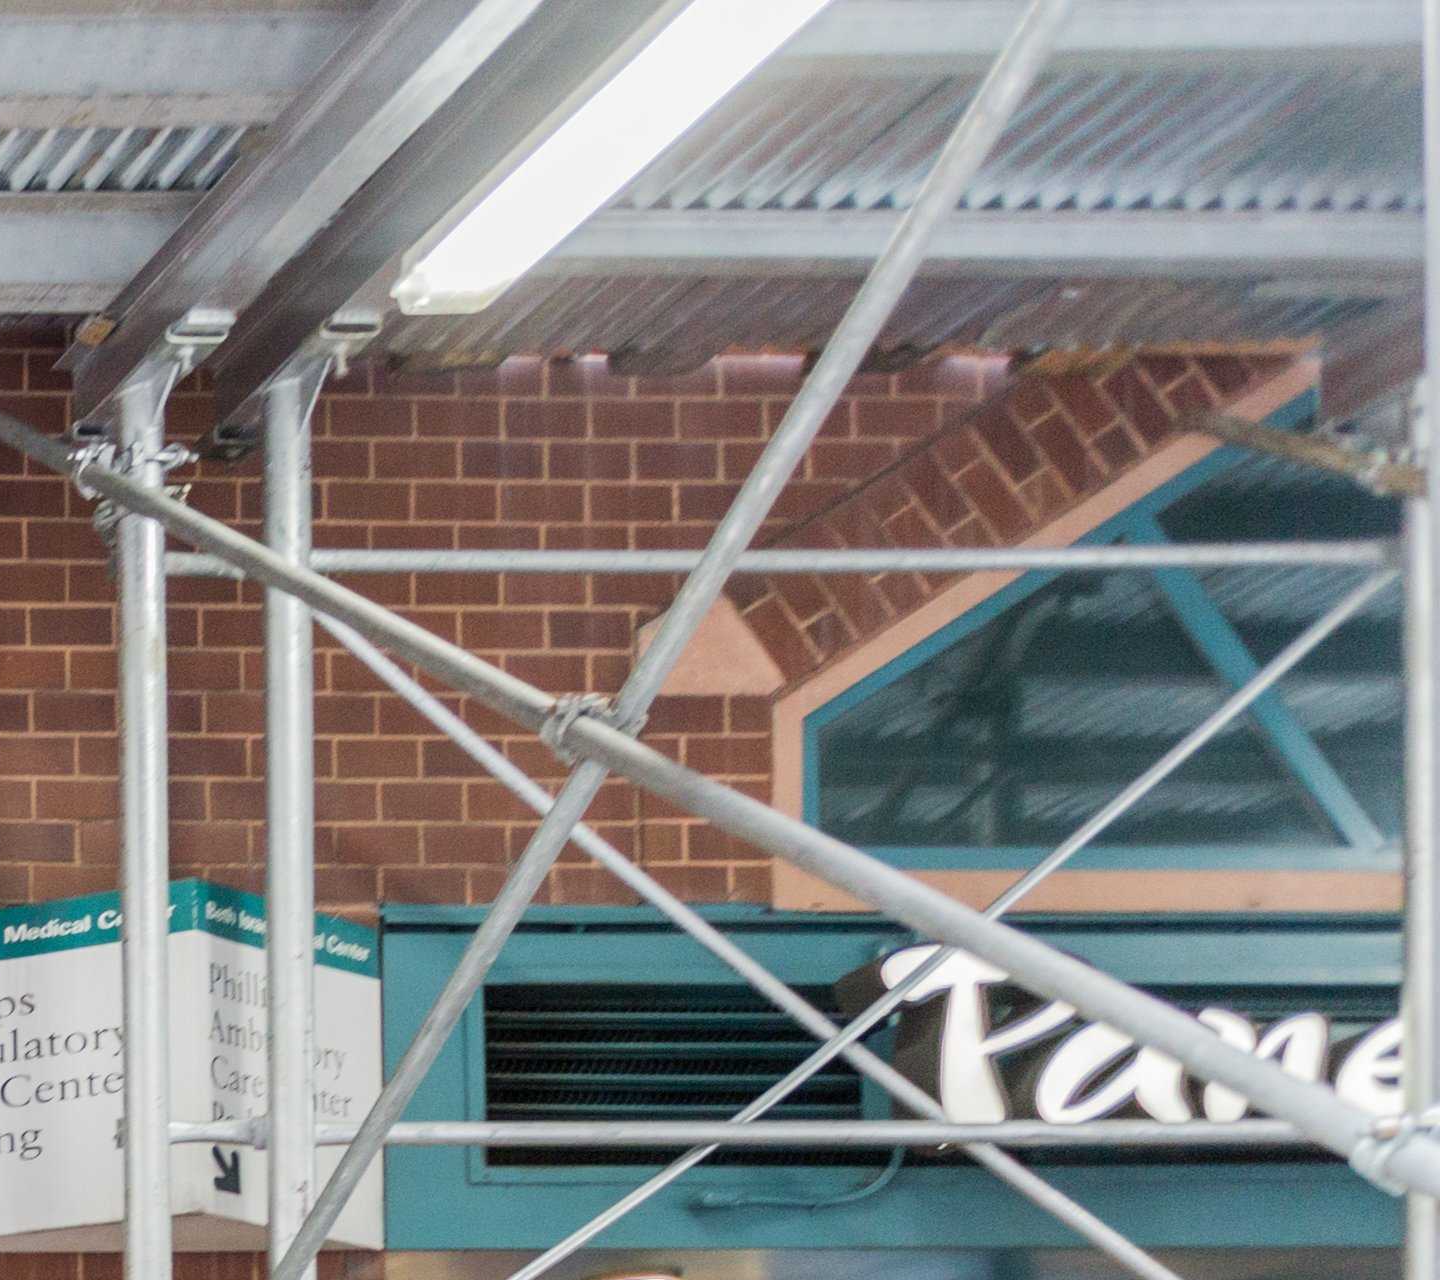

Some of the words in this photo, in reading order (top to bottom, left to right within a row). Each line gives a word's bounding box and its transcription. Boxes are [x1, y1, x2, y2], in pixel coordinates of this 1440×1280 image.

[3, 914, 92, 944] Medical
[326, 933, 371, 962] Center
[0, 1072, 126, 1109] Cente
